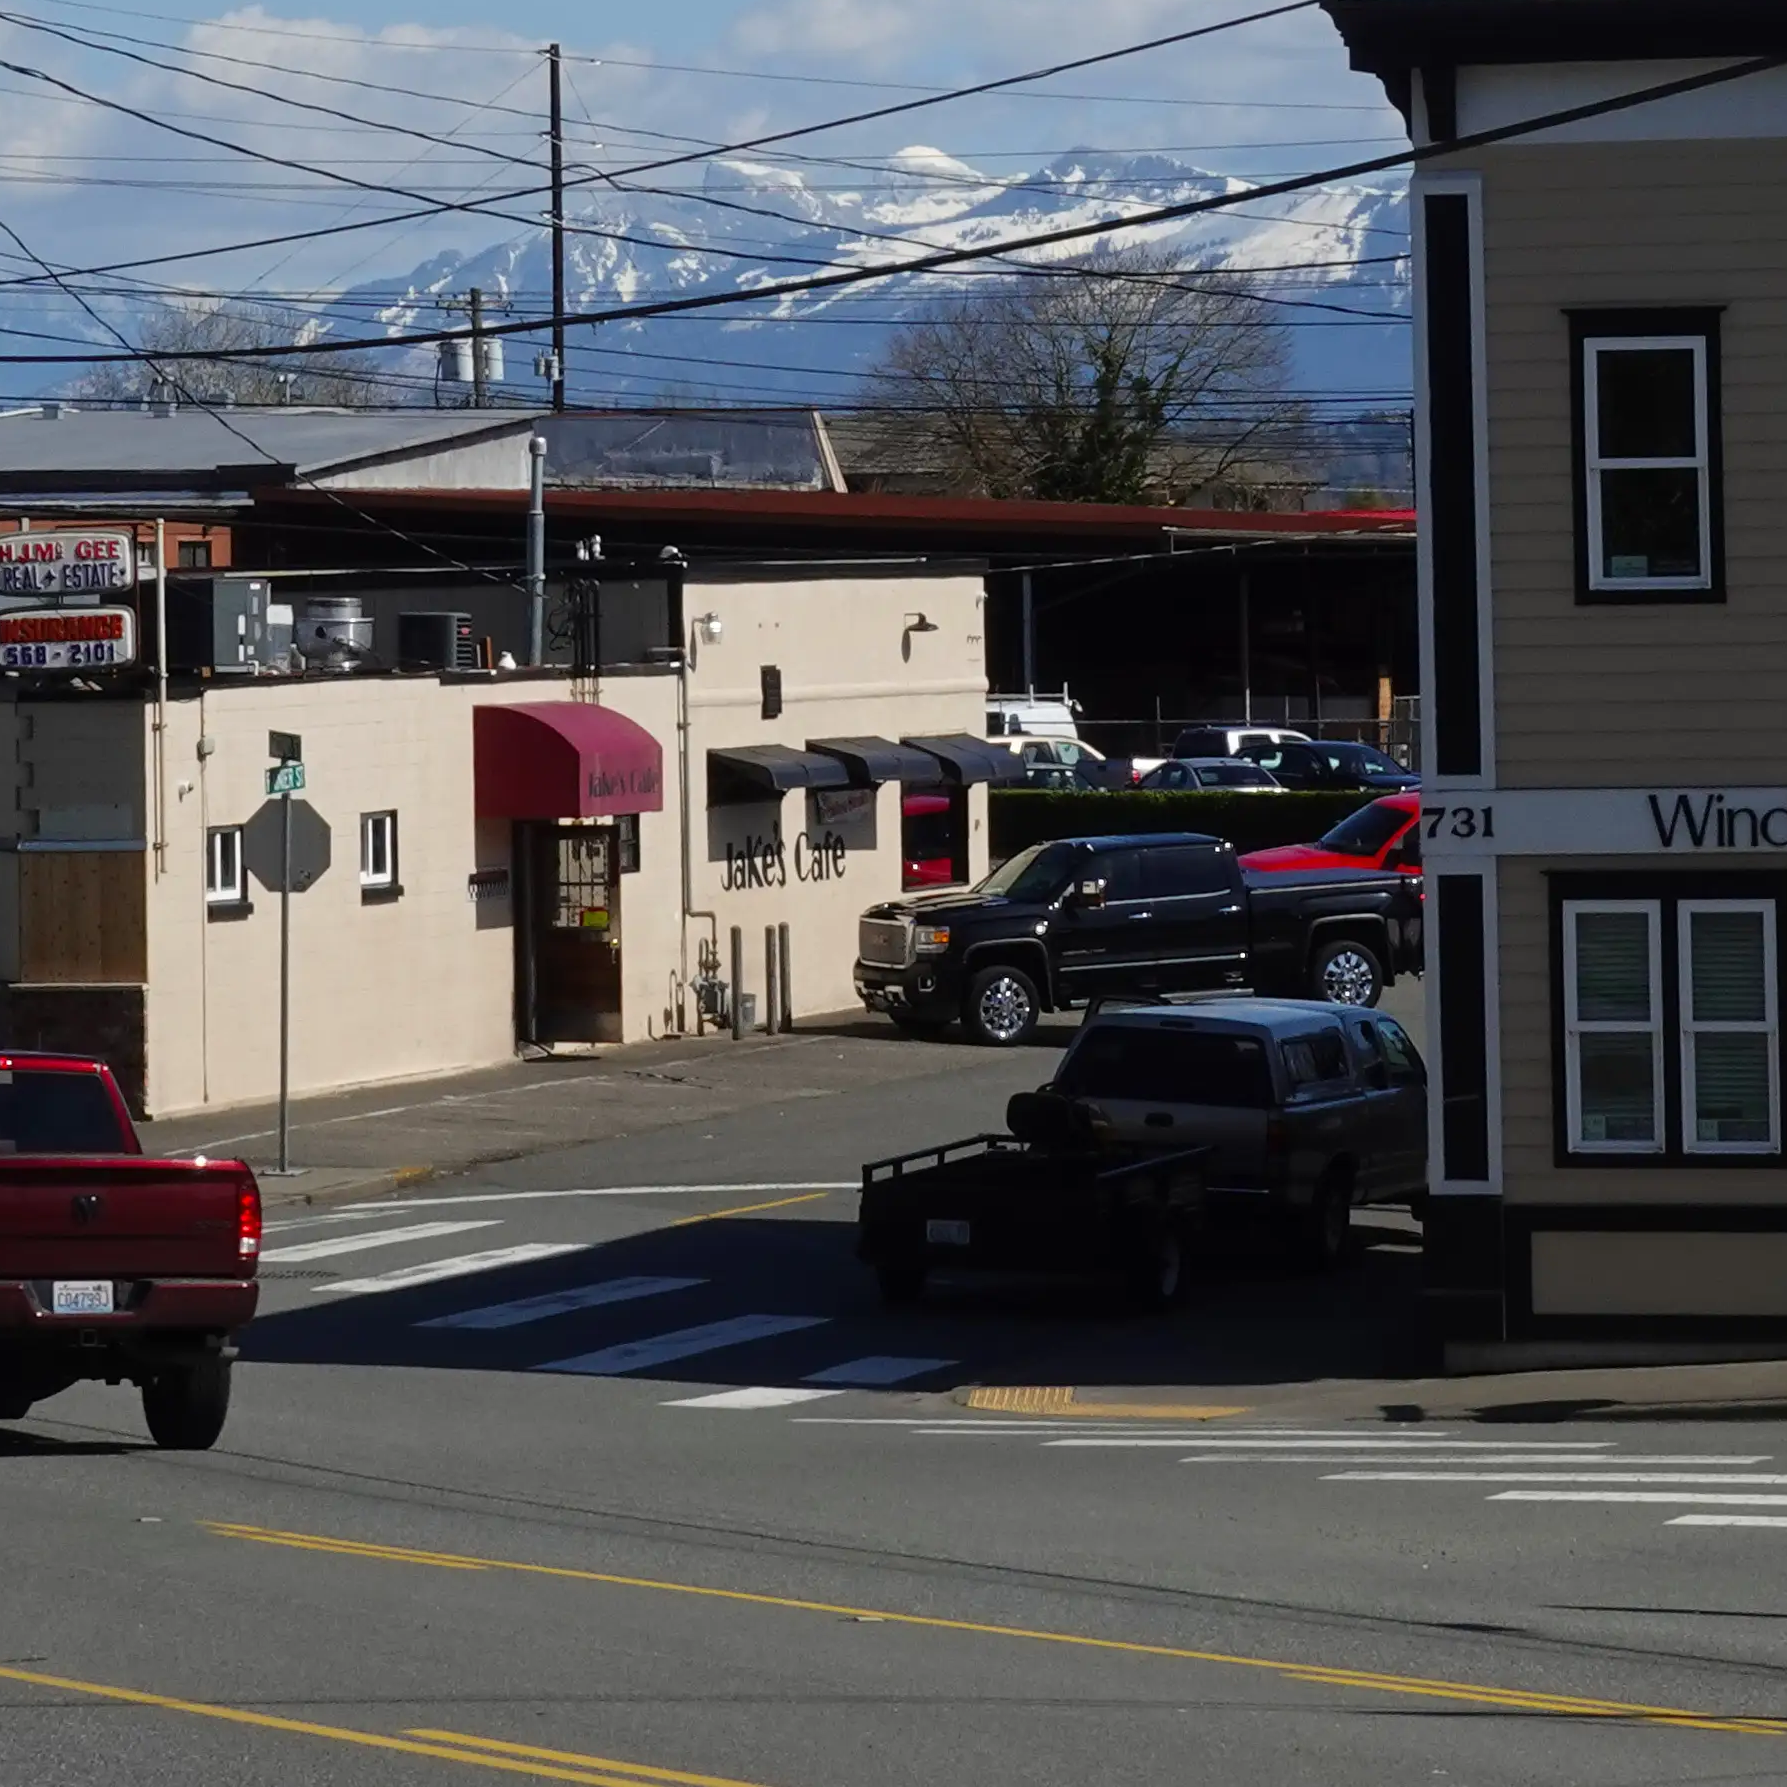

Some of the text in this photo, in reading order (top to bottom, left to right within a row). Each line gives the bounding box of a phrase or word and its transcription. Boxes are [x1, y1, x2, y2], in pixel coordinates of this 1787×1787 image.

[74, 540, 119, 560] GEE
[2, 563, 119, 591] REAL ESTATE
[1422, 806, 1494, 838] 731
[794, 830, 846, 882] Cafe
